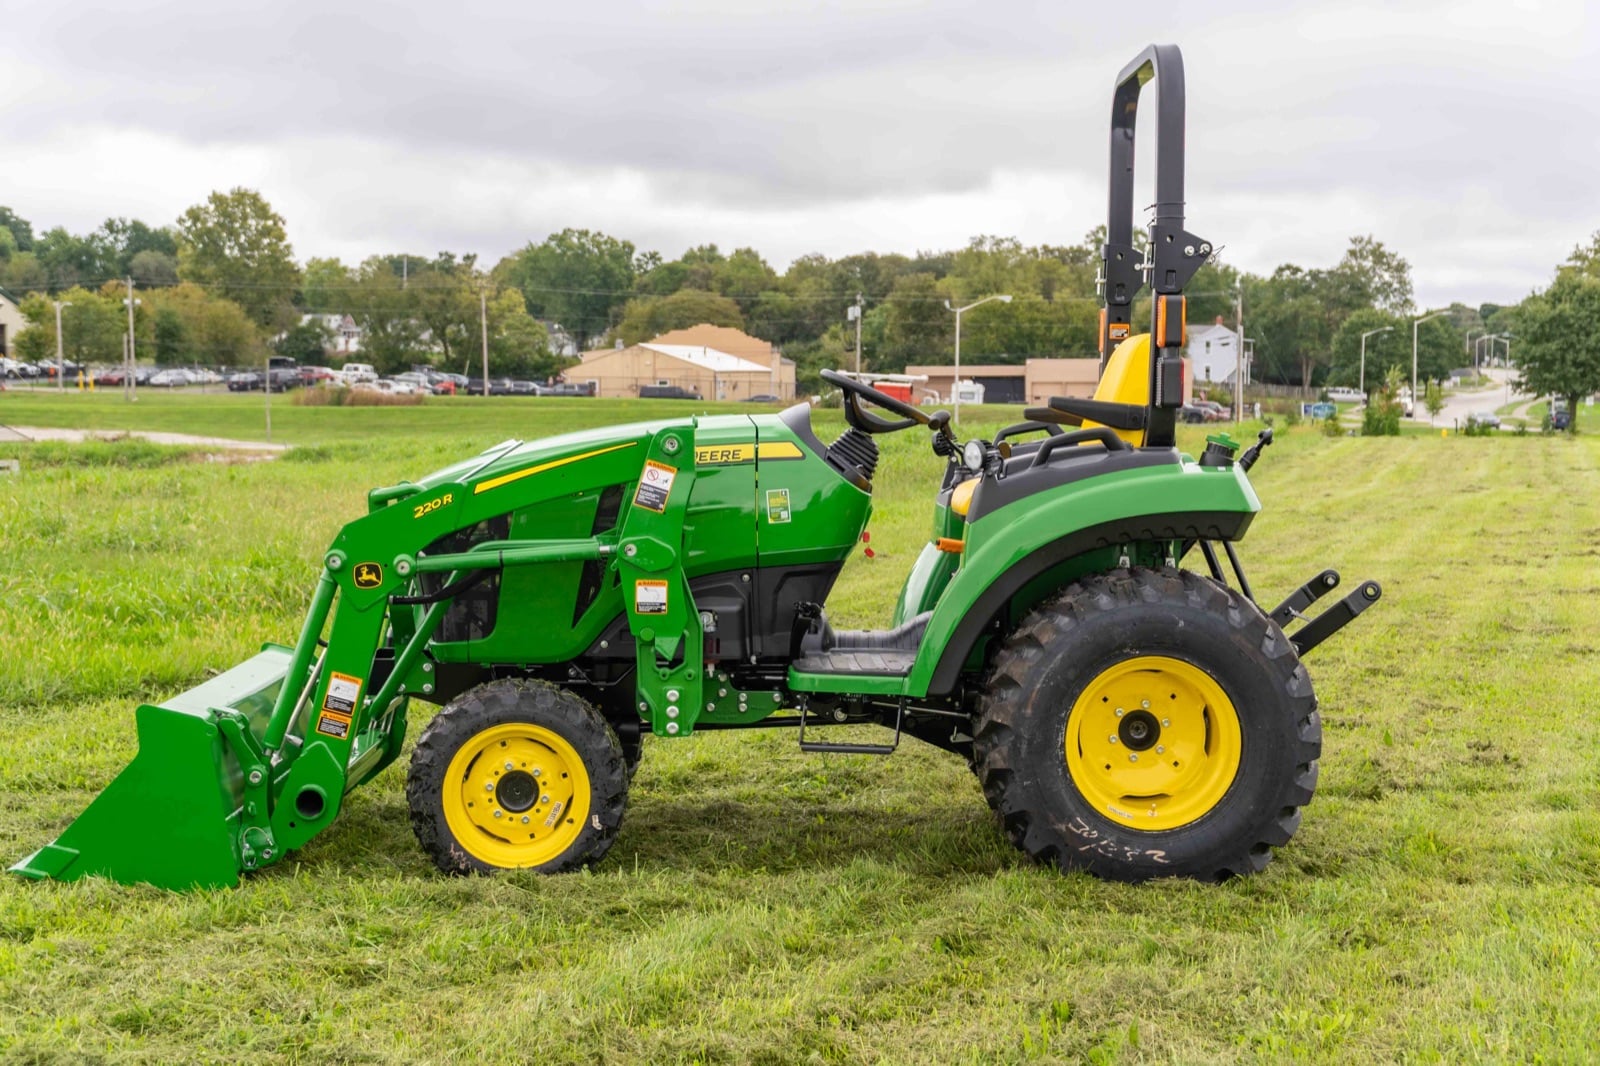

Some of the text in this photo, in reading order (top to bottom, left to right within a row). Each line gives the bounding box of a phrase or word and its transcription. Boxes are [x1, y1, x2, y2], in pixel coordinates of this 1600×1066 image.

[695, 449, 742, 462] EERE
[414, 493, 453, 519] 220 R
